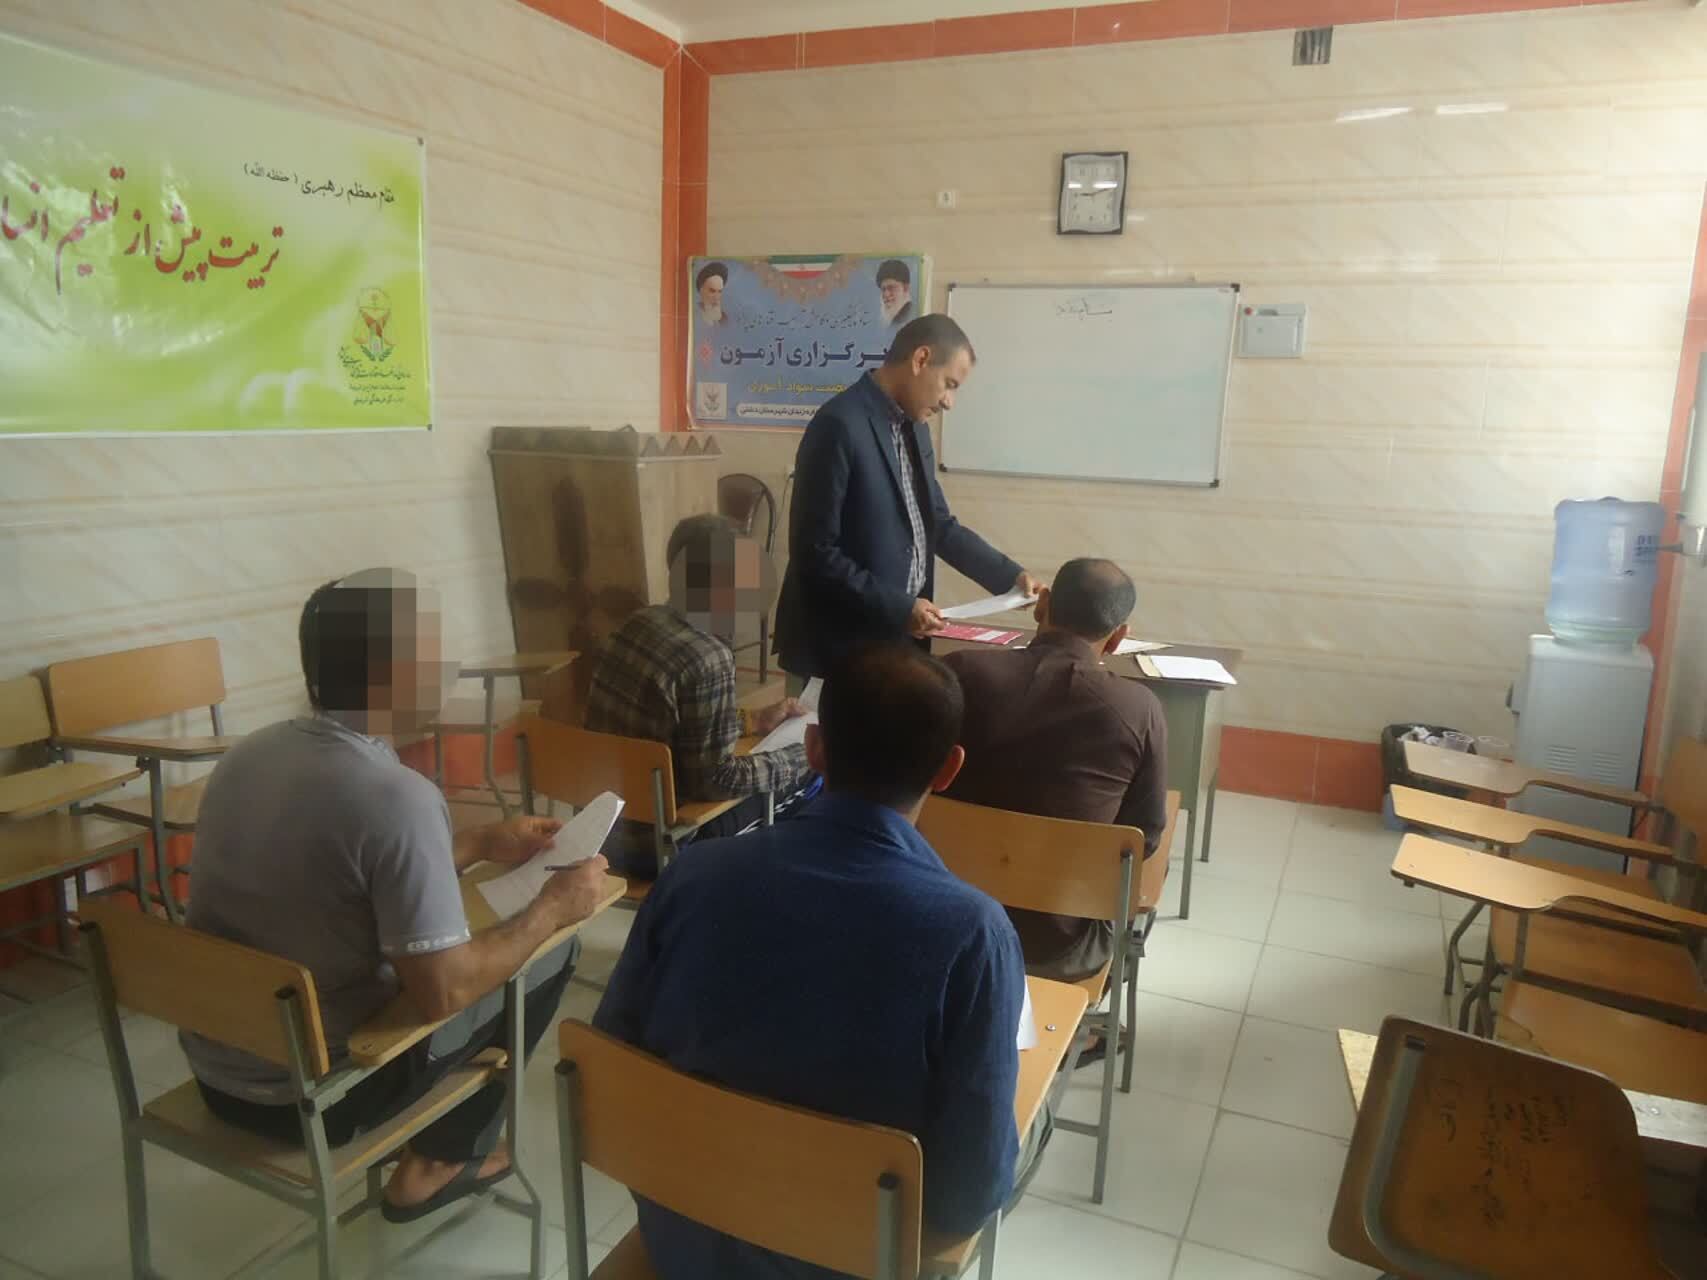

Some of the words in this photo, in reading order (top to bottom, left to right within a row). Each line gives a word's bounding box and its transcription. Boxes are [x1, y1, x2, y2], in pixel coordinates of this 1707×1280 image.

[1, 182, 49, 243] انسا
[301, 179, 344, 198] رهبری
[347, 182, 377, 206] معظم
[124, 208, 151, 256] از
[155, 201, 209, 283] پیش
[208, 226, 285, 289] تربیت
[720, 336, 785, 367] آزمون
